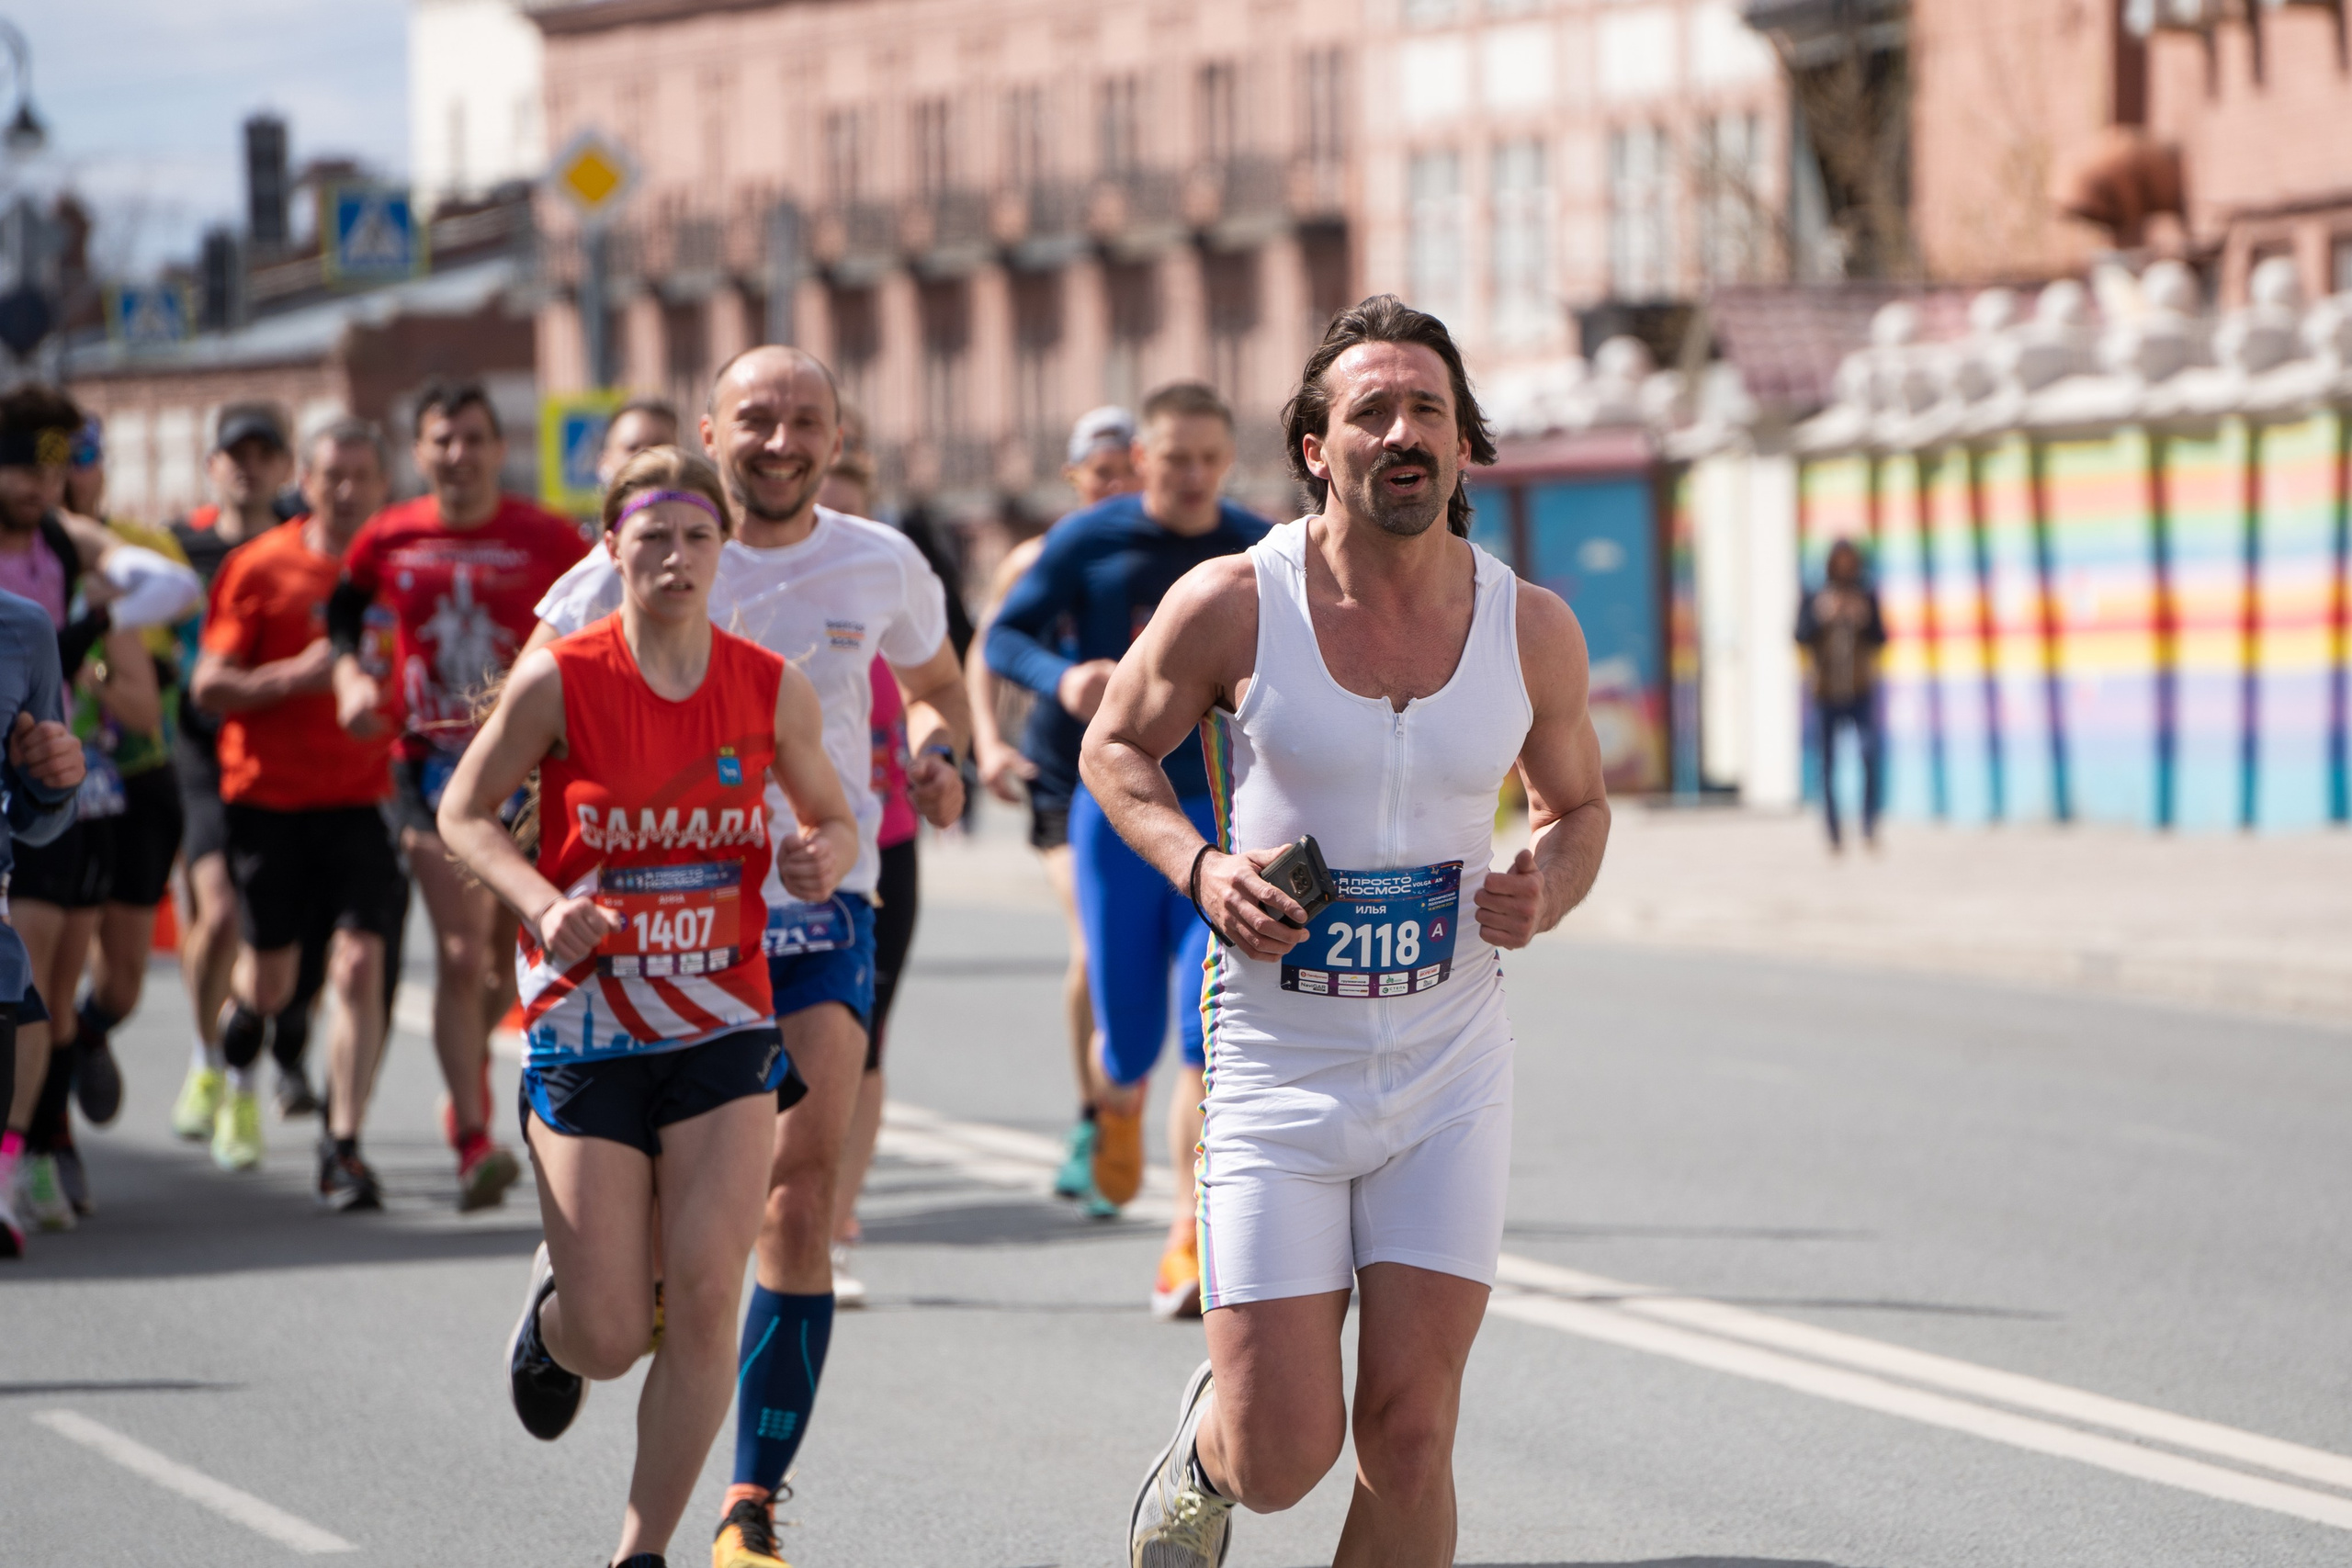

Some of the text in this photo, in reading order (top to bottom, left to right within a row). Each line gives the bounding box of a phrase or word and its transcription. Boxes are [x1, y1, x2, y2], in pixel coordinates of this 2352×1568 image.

[1351, 876, 1412, 886] ПРОСТО
[1338, 885, 1412, 896] КОСМОС
[1355, 905, 1386, 914] ИЛЬЯ
[633, 906, 715, 953] 1407
[1326, 920, 1420, 968] 2118
